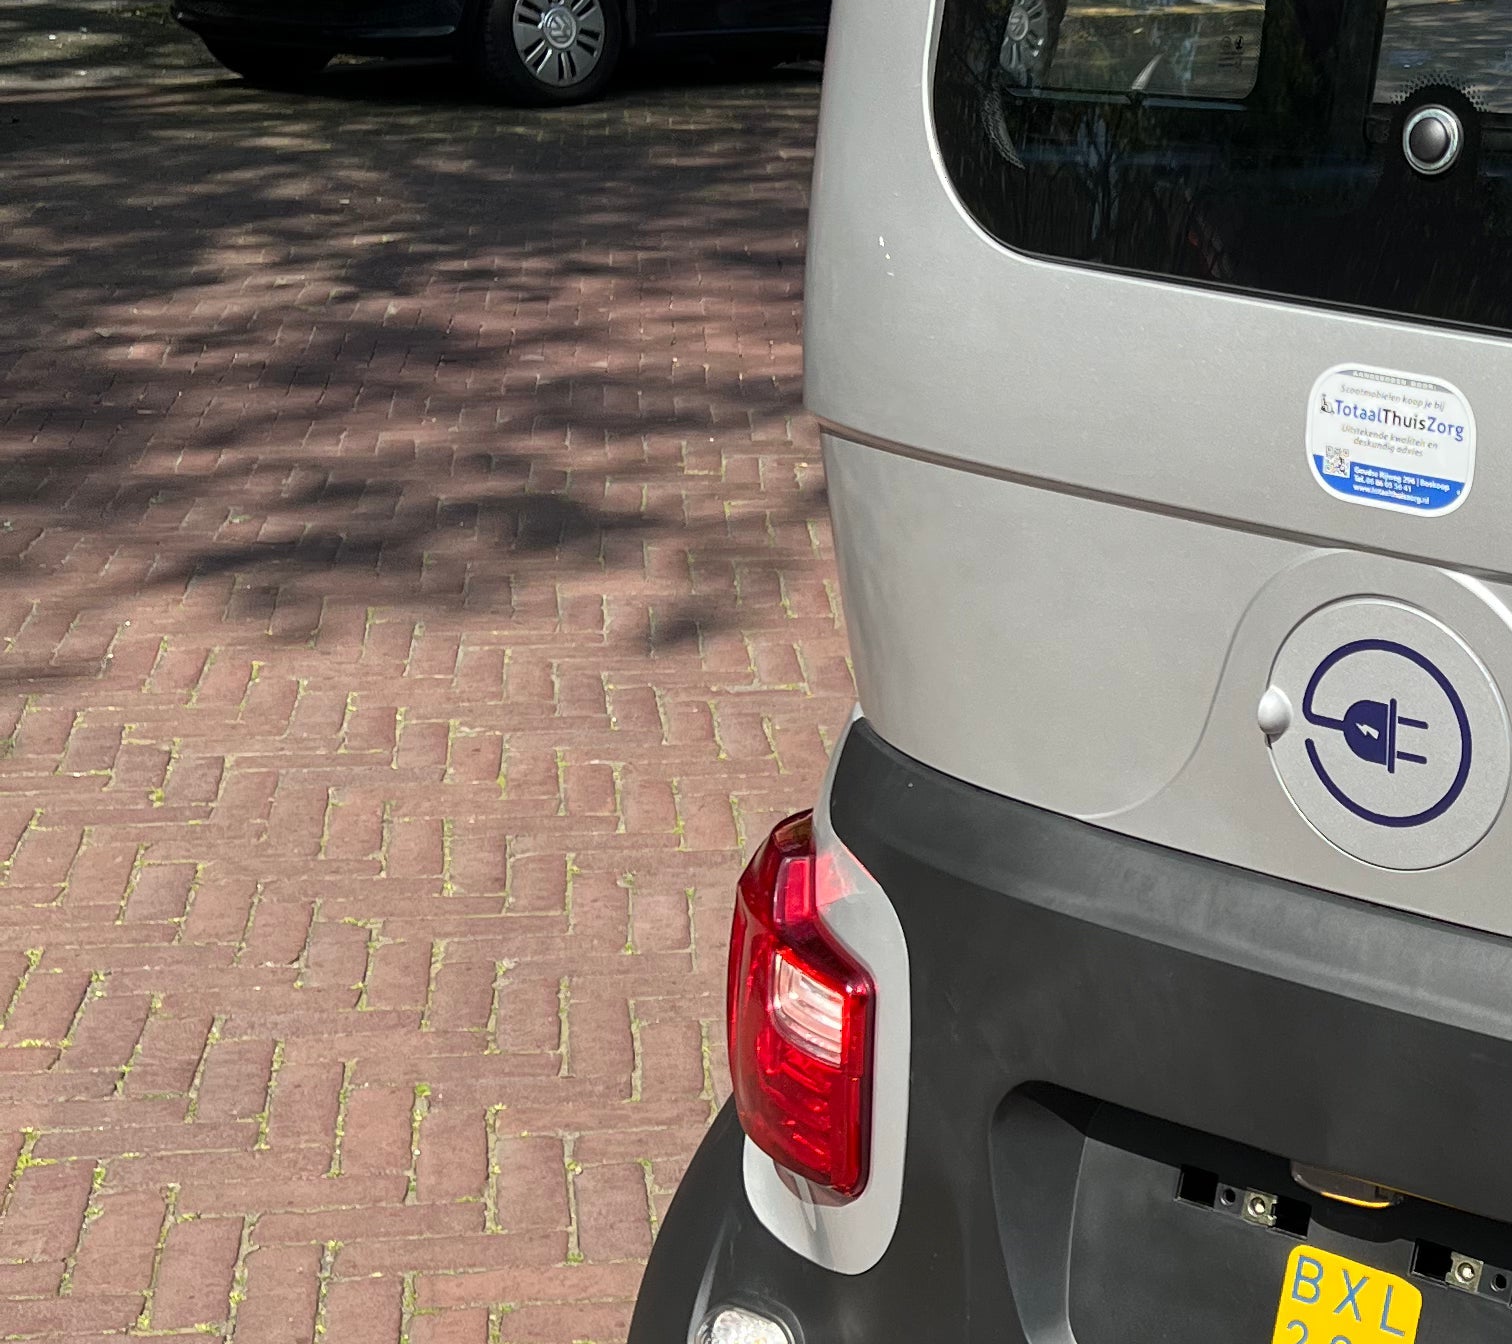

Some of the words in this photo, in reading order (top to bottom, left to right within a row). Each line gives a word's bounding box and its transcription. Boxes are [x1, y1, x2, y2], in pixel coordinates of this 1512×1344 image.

[1340, 384, 1401, 402] Scootmobielen
[1402, 396, 1423, 408] koop
[1424, 400, 1432, 409] je
[1434, 401, 1445, 413] bij
[1334, 399, 1465, 442] TotaalThuisZorg
[1353, 437, 1395, 454] deskundig
[1396, 446, 1423, 457] advies
[1427, 441, 1438, 449] en
[1291, 1254, 1405, 1337] BXL
